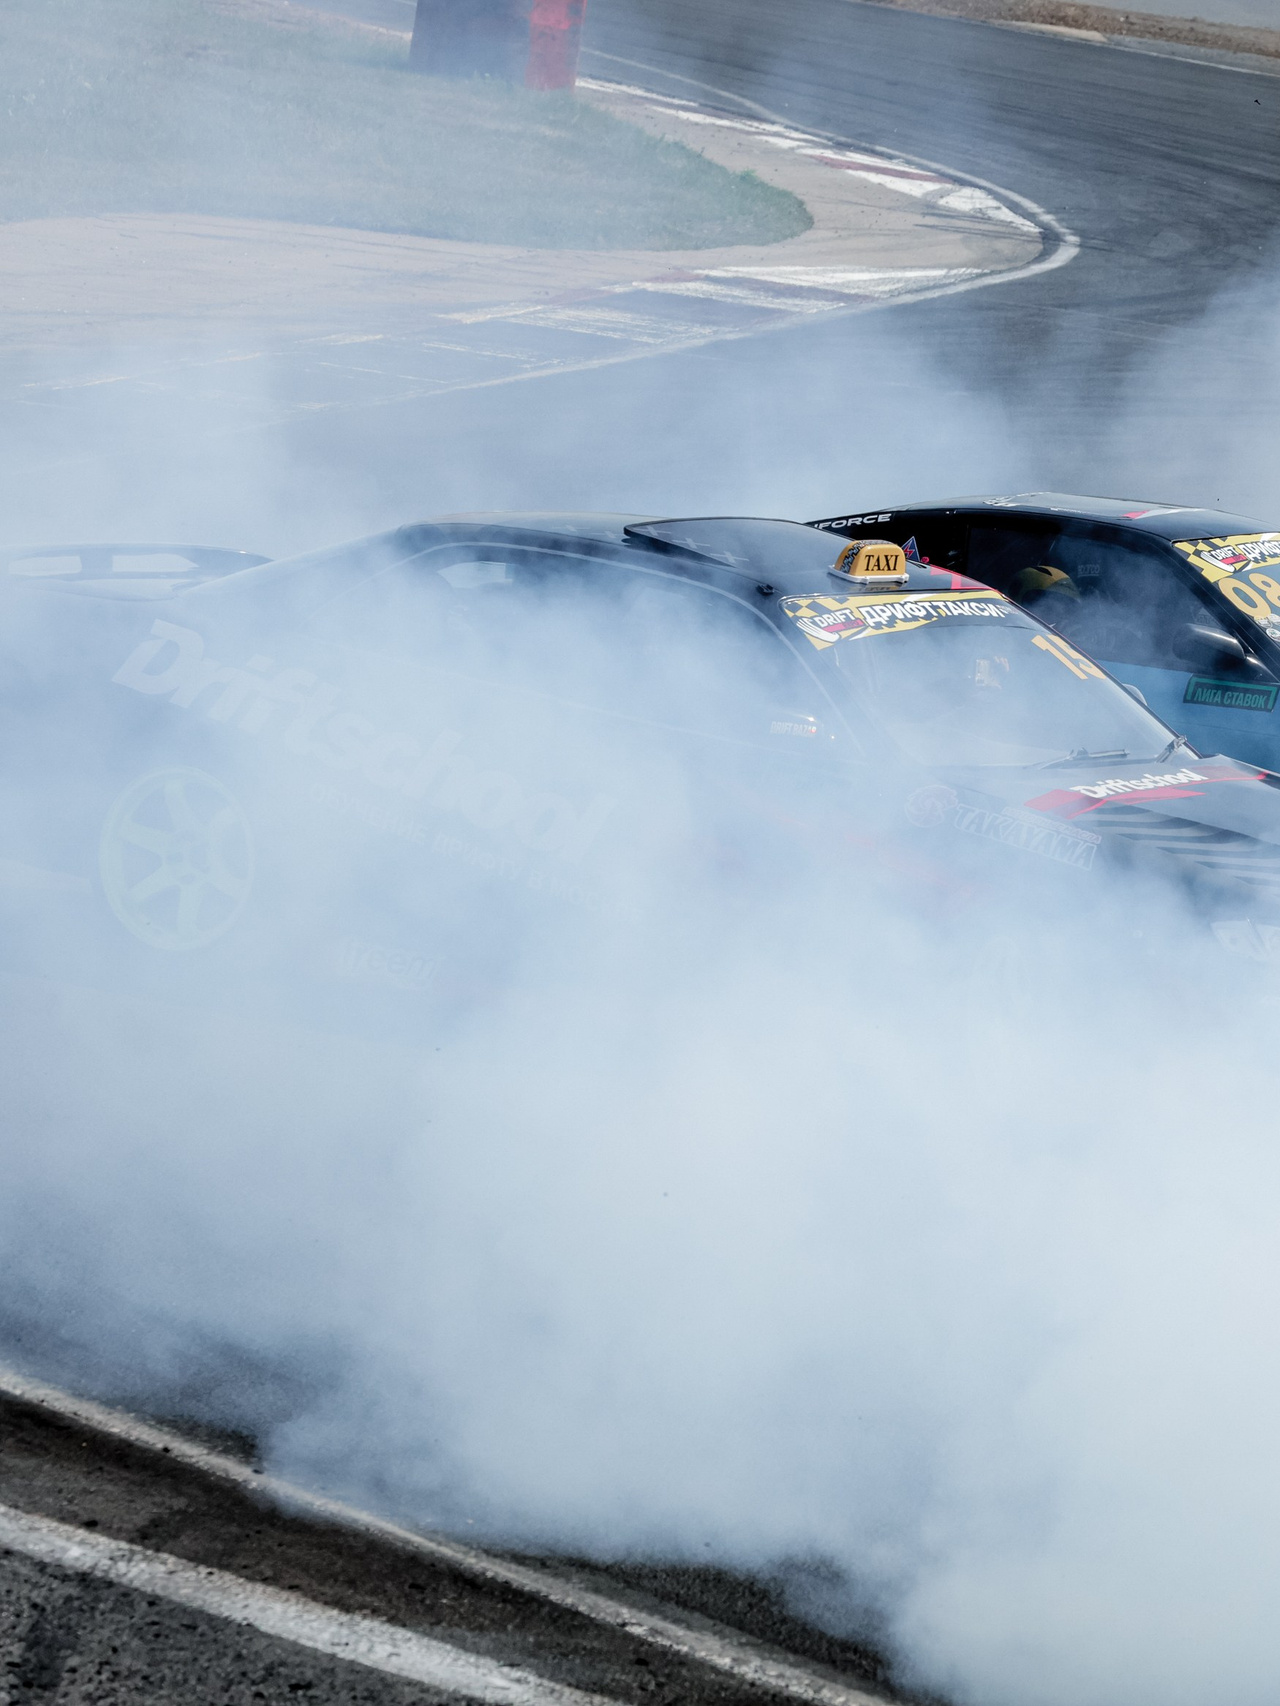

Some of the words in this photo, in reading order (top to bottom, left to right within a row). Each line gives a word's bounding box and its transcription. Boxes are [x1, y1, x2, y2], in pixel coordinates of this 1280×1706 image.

[864, 554, 899, 571] TAXI
[1210, 545, 1239, 560] DRIFT
[812, 608, 856, 628] DRIFT
[1193, 687, 1221, 704] ЛИГА
[1223, 691, 1268, 709] СТАВОК
[955, 804, 1096, 869] TAKAYAMA
